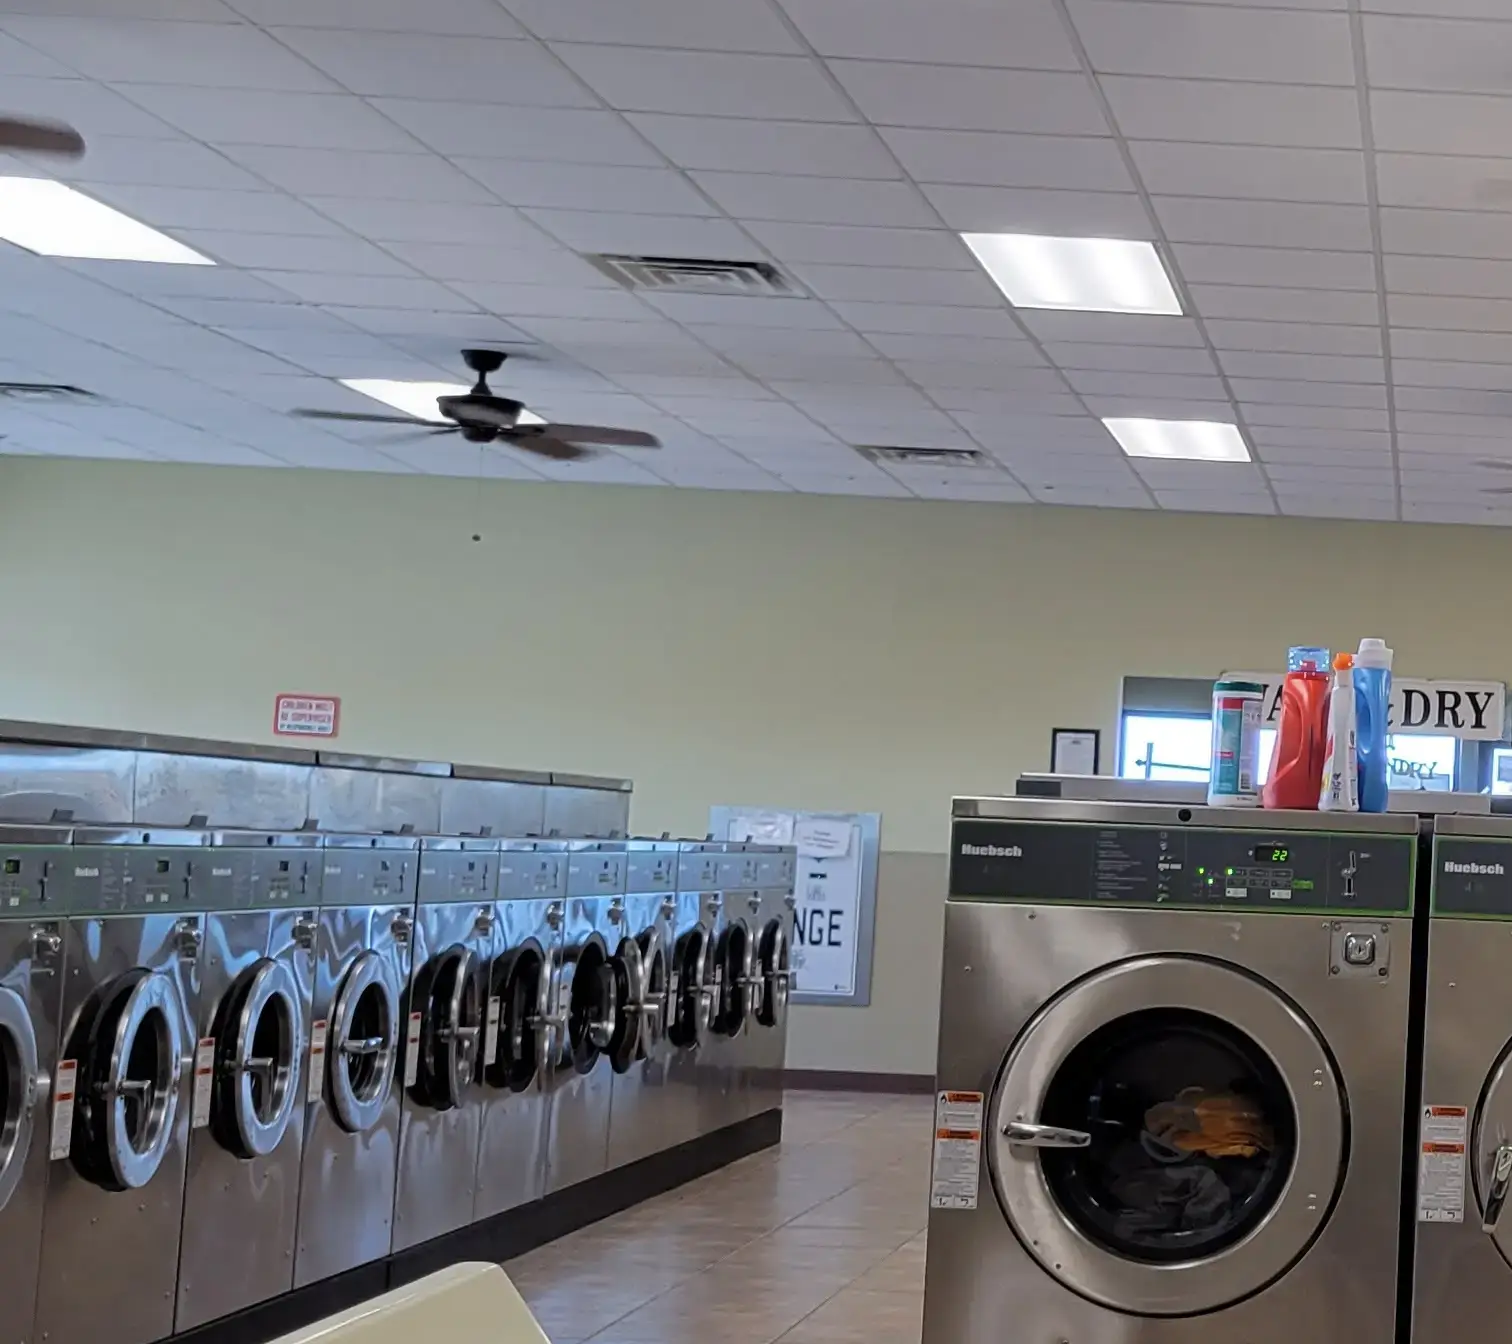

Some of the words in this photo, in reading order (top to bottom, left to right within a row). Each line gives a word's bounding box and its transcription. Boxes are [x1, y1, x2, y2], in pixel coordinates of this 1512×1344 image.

[1401, 689, 1494, 729] DRY
[961, 843, 1023, 857] Huebsch
[1272, 849, 1288, 862] 22
[1444, 861, 1505, 875] Huebsch
[792, 907, 844, 947] NGE
